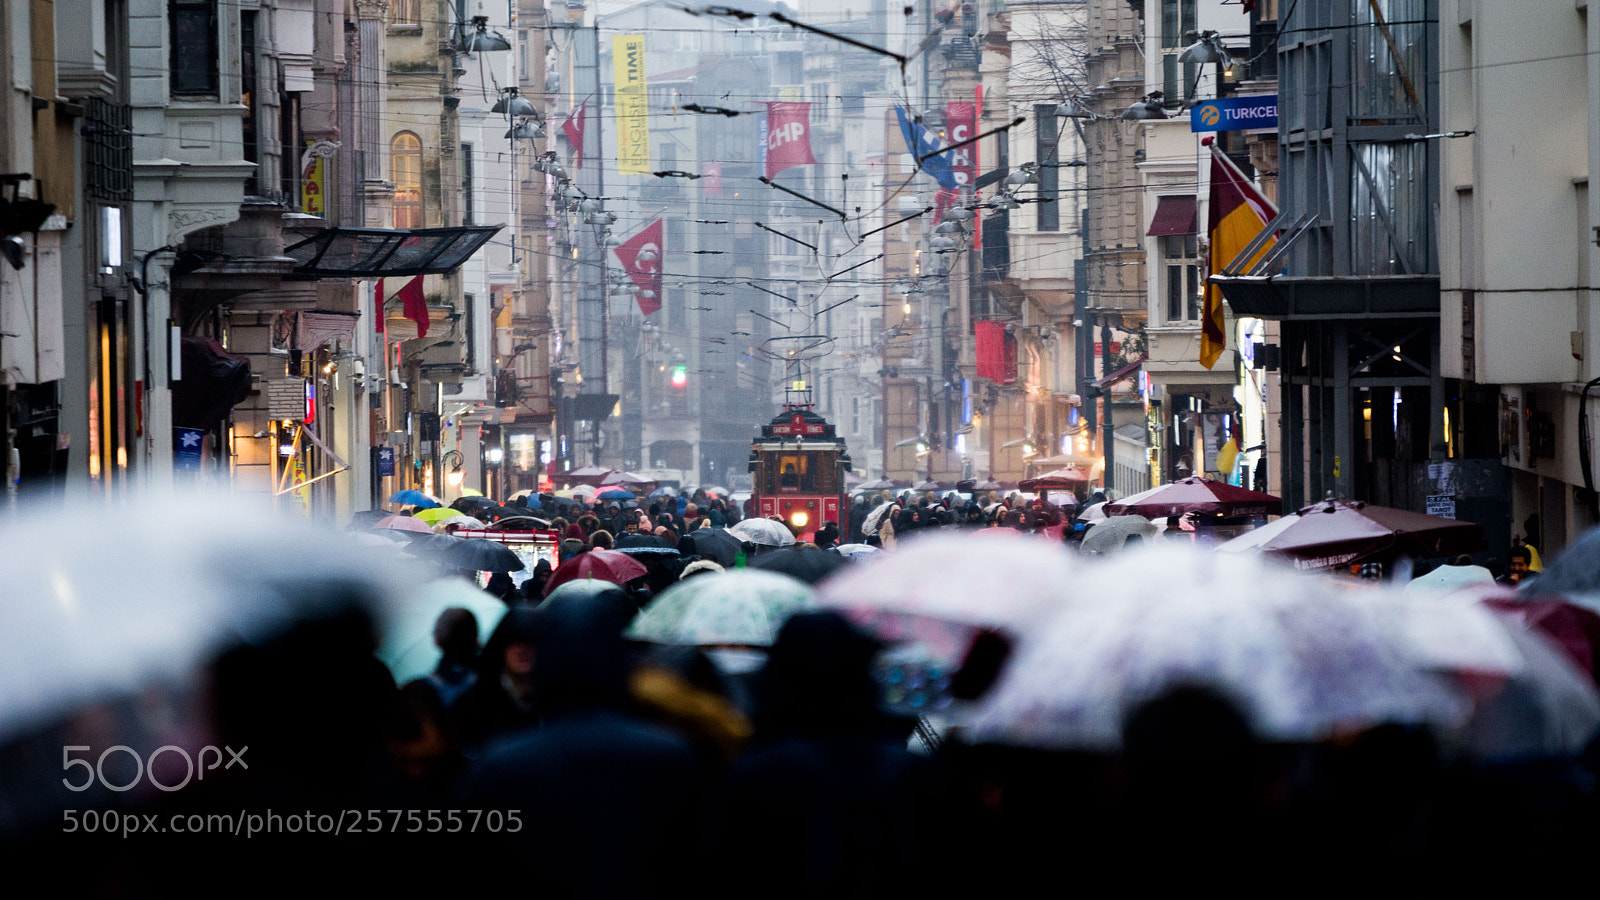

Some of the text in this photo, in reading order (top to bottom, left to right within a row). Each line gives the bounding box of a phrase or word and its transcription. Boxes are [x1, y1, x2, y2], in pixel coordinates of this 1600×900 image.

[626, 42, 638, 82] TIME
[630, 96, 643, 166] ENGLISH
[768, 122, 804, 150] CHP
[952, 125, 969, 189] CHP
